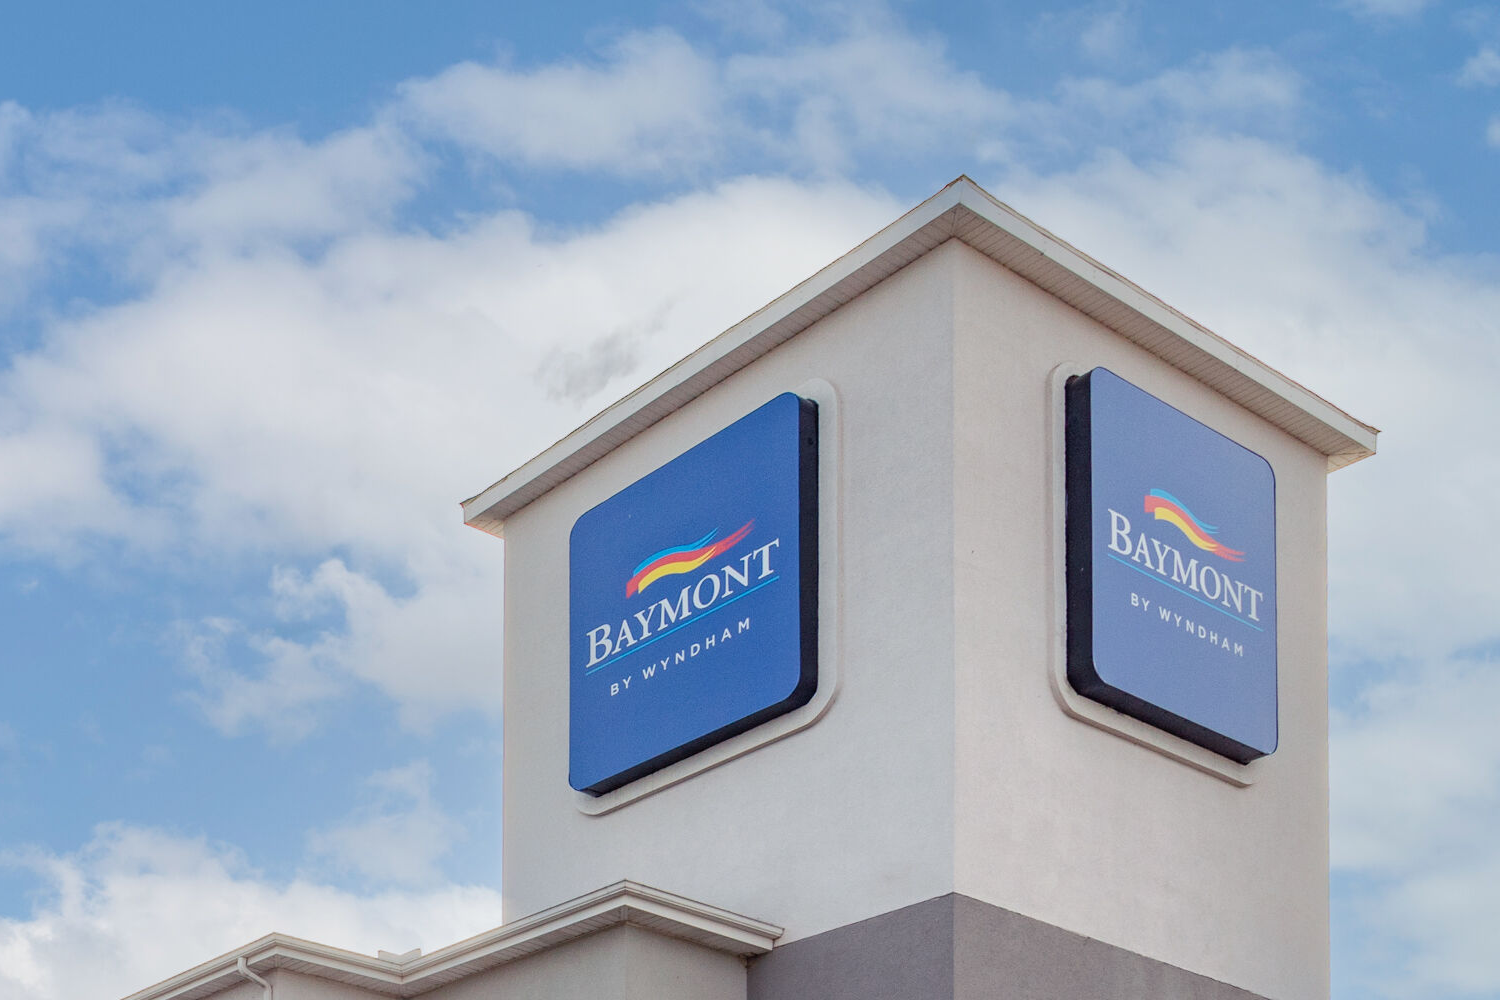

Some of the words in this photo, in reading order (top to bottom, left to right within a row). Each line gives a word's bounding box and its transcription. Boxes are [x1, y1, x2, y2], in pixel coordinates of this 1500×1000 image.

[586, 538, 780, 668] BAYMONT
[1107, 508, 1263, 622] BAYMONT
[610, 675, 632, 697] BY
[642, 617, 751, 680] WYNDHAM
[1131, 592, 1150, 612] BY
[1158, 606, 1244, 657] WYNDHAM
